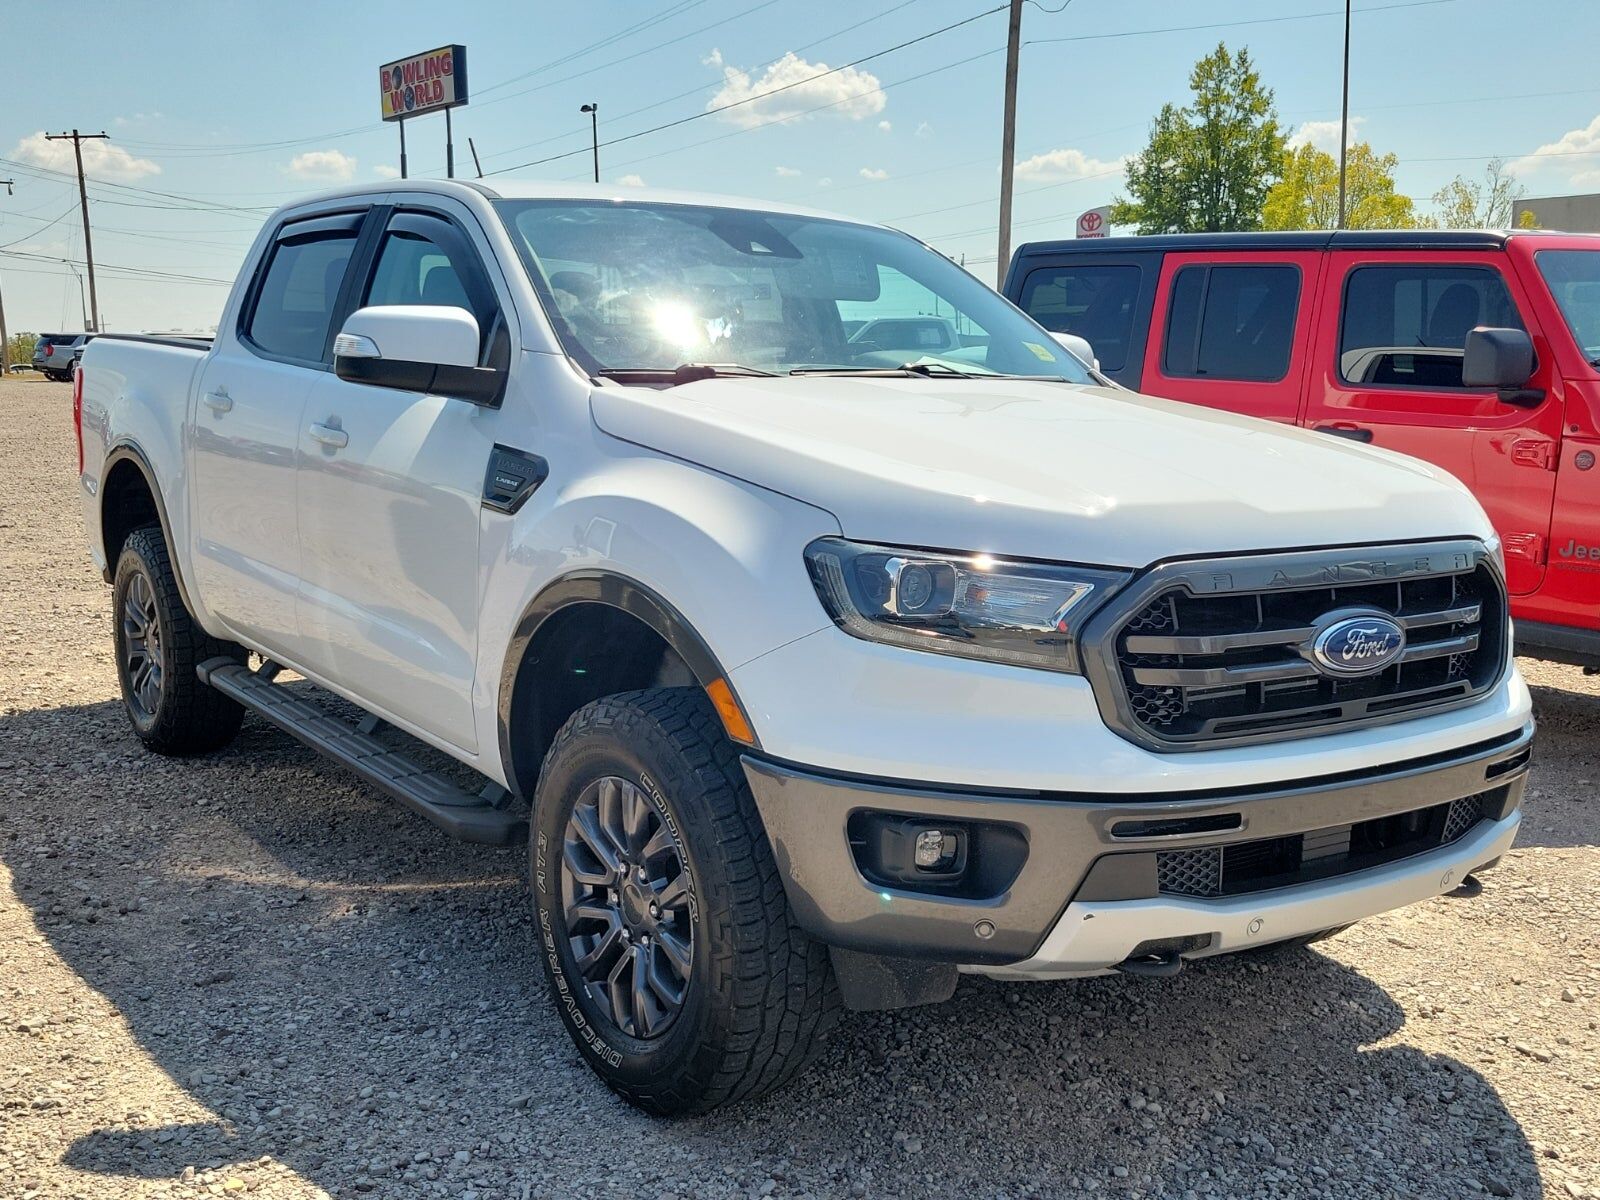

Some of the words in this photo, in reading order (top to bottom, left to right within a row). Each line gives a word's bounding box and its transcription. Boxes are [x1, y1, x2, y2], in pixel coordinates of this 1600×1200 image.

[382, 53, 453, 93] BOWLING
[391, 79, 444, 113] WORLD
[1558, 539, 1600, 561] Jee
[1211, 553, 1474, 591] RANGER
[1341, 628, 1389, 660] Ford
[537, 830, 549, 894] AT3
[640, 771, 699, 923] COOPER
[540, 908, 623, 1068] DISCOVERER
